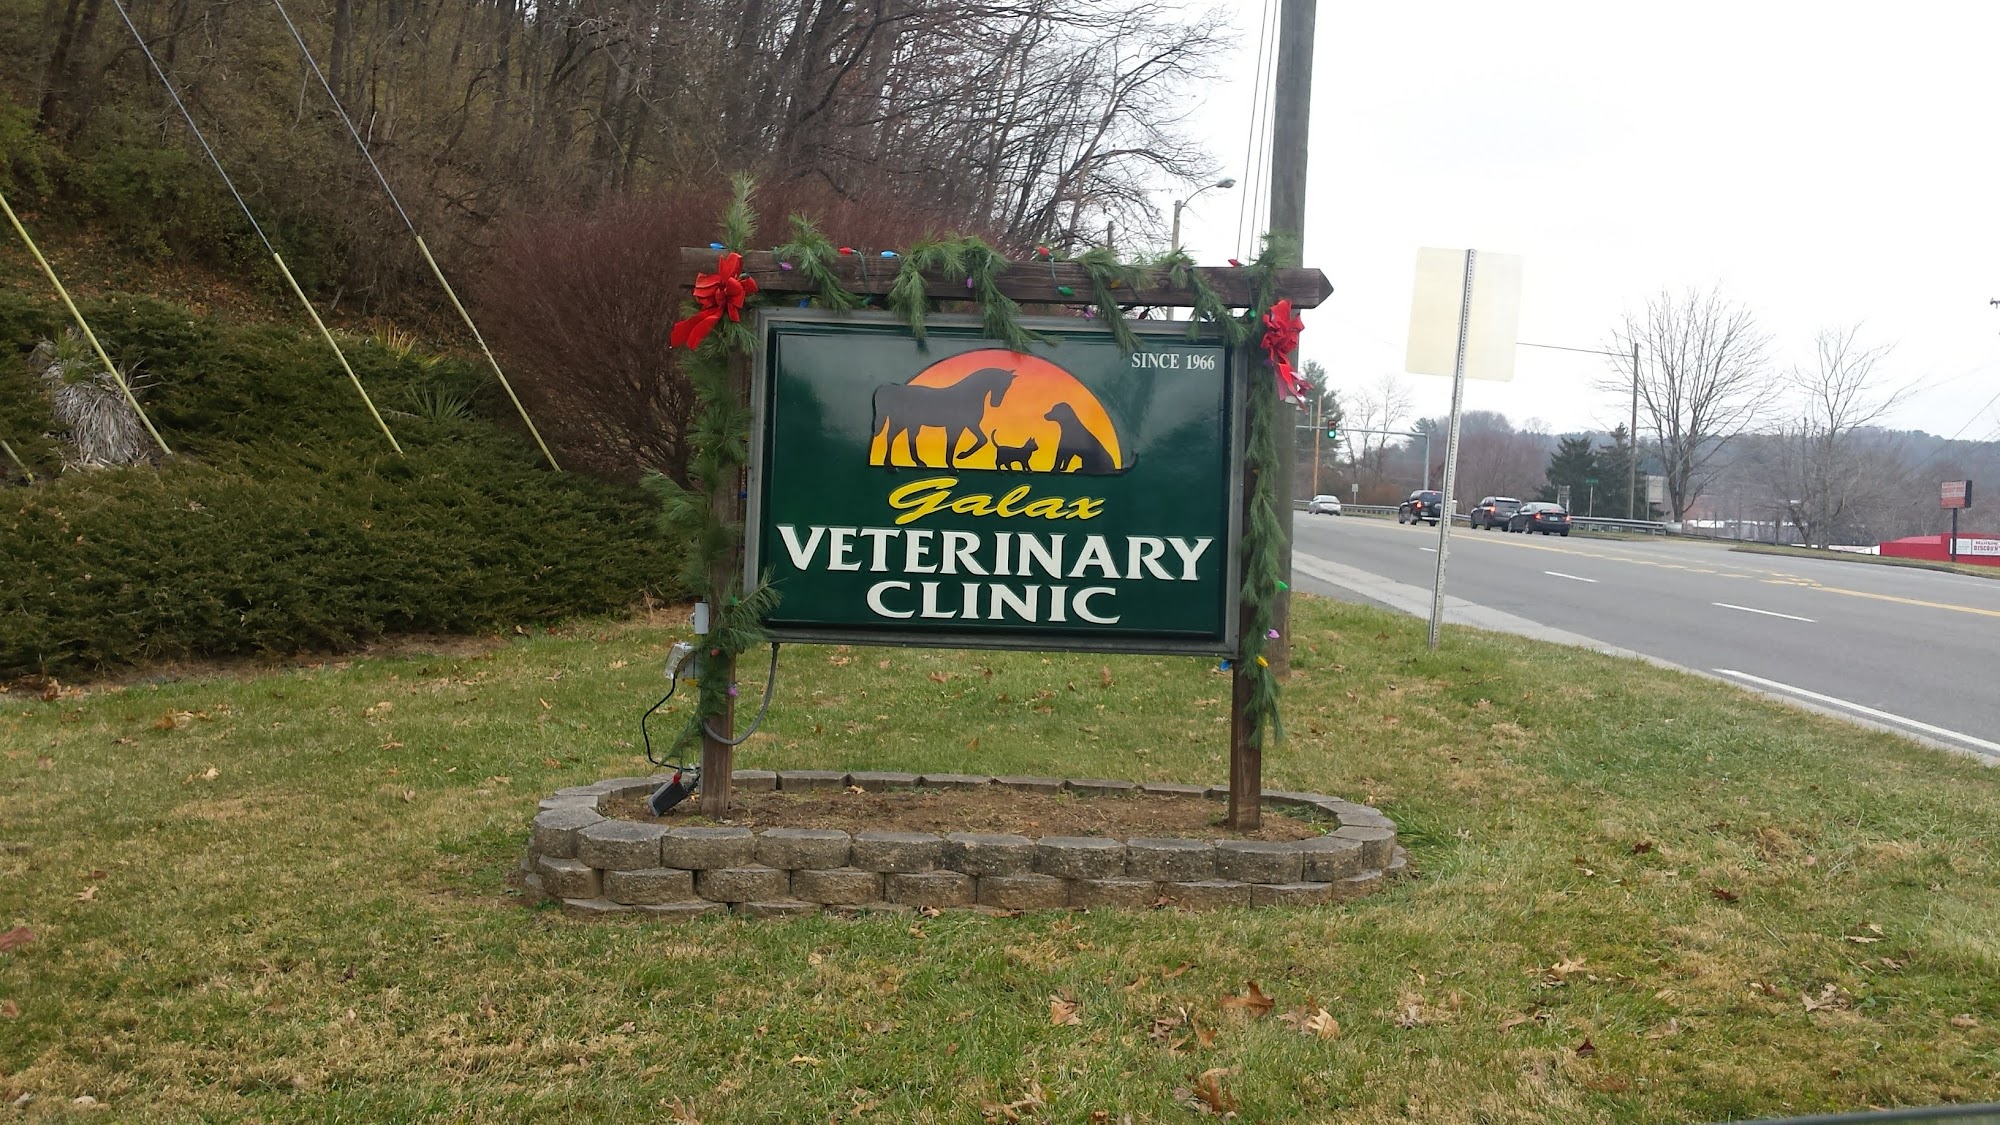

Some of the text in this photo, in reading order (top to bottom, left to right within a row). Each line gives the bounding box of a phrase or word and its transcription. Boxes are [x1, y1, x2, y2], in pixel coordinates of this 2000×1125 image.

[1131, 352, 1215, 371] SINCE 1966
[888, 477, 1103, 525] Galax
[777, 525, 1214, 581] VETERINARY
[866, 580, 1121, 624] CLINIC
